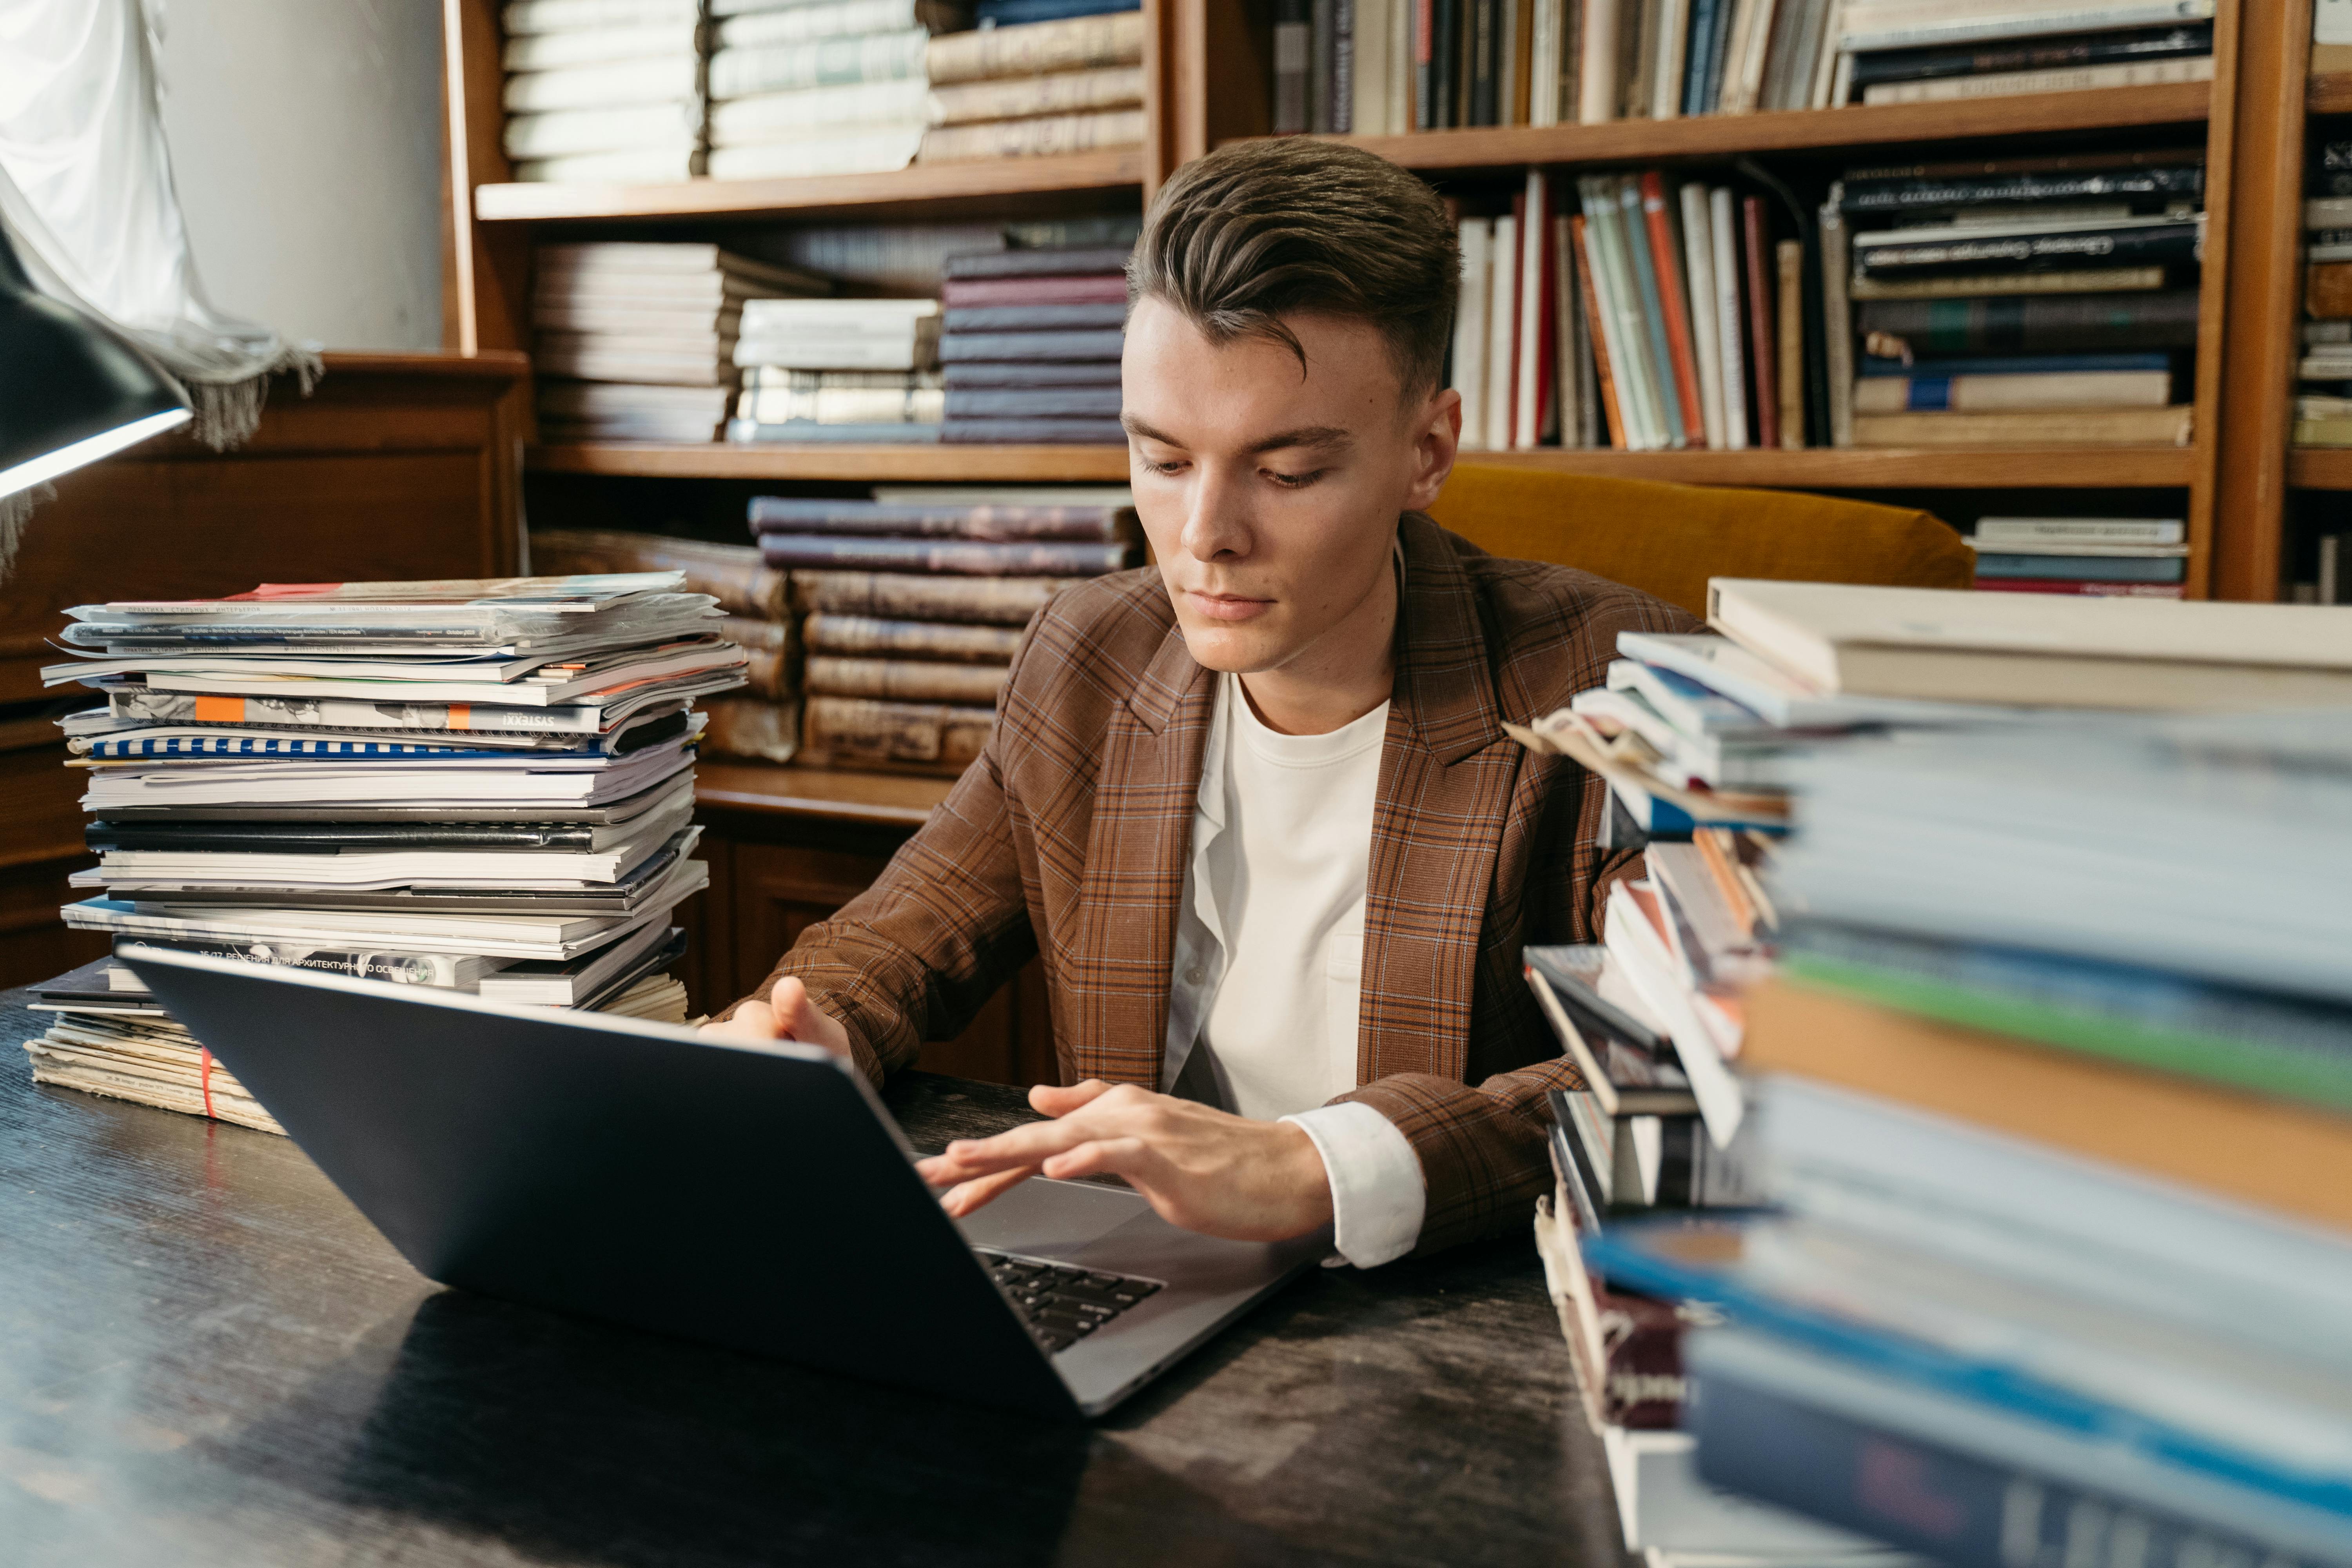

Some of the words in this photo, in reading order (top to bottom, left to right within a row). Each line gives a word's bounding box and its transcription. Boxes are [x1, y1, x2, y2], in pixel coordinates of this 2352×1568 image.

[200, 950, 222, 959] 16/17
[226, 953, 270, 964] РЕШЕНИЯ
[272, 956, 291, 966] ДЛЯ
[292, 959, 374, 972] АРХИТЕКТУРНОГО
[376, 965, 434, 976] ОСВЕЩЕНИЯ
